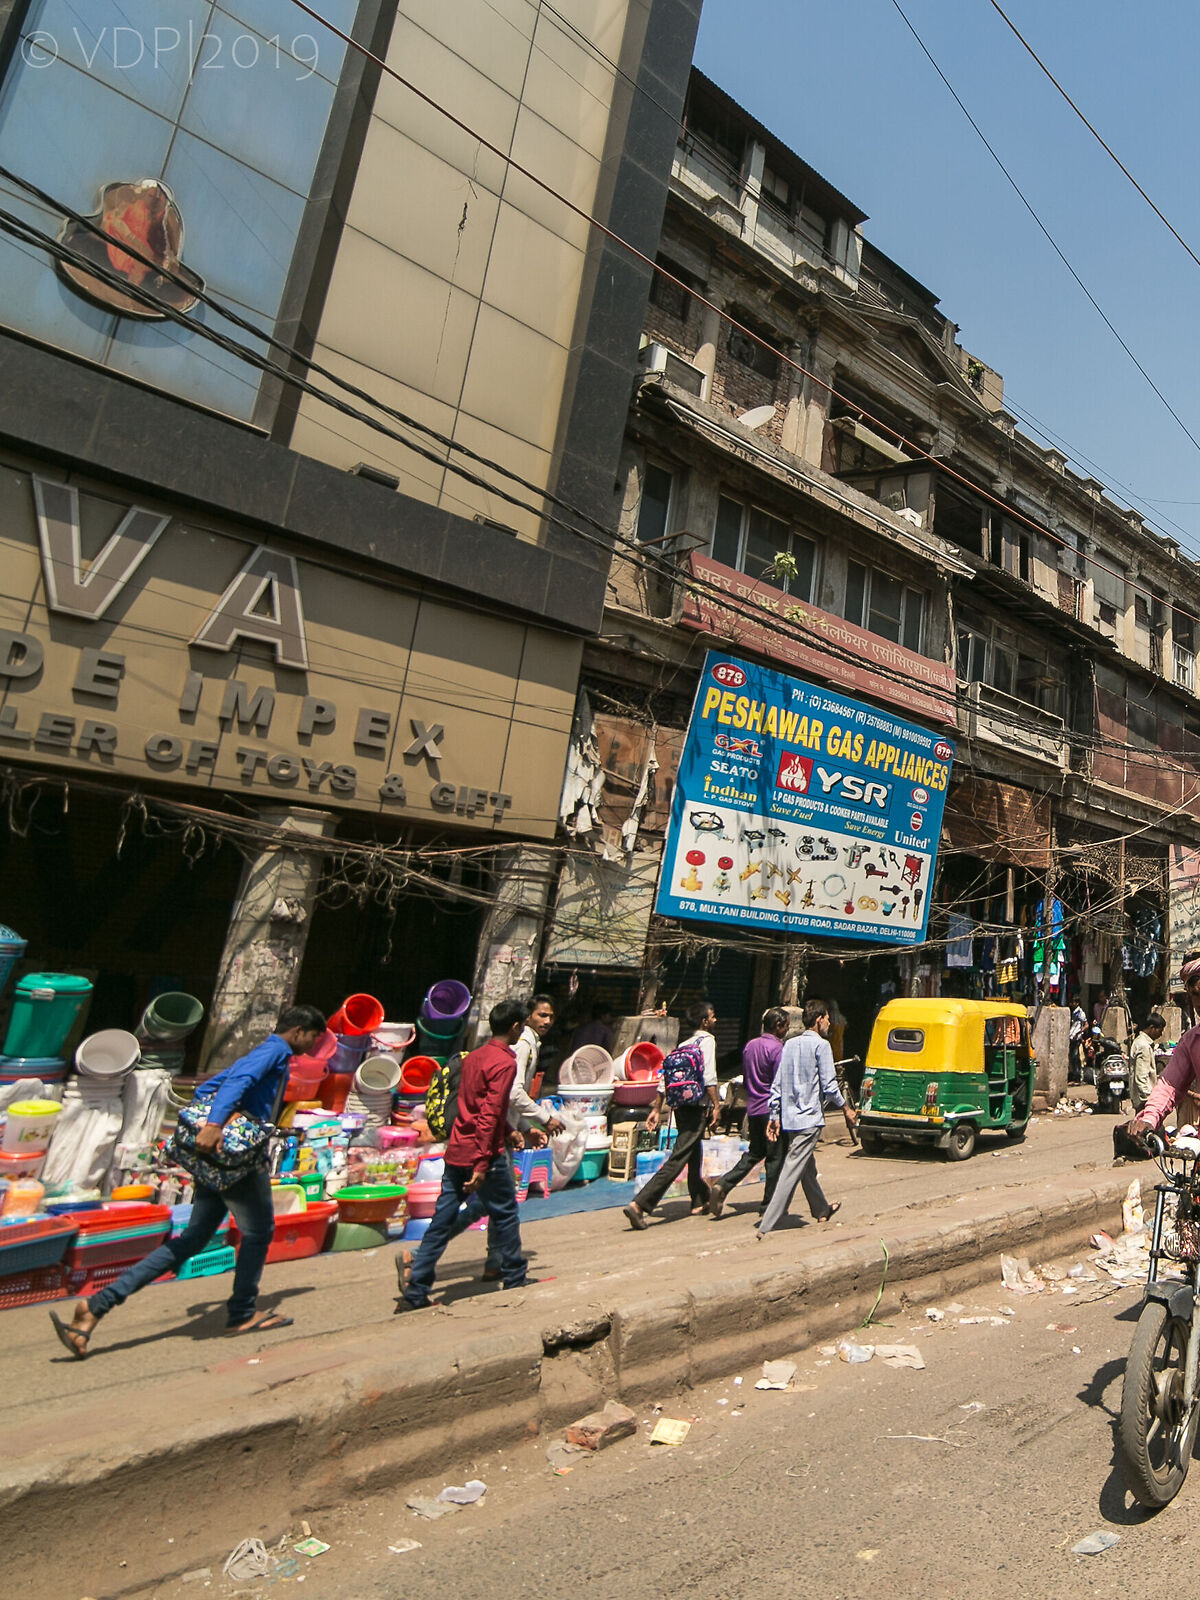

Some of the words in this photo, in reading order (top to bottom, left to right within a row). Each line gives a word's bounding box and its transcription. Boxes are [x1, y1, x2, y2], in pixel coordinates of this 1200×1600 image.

[695, 564, 733, 593] सदर
[716, 666, 744, 685] 878
[791, 687, 804, 702] PH
[178, 668, 445, 760] IMPEX
[701, 686, 824, 751] PESHAWAR
[826, 725, 865, 763] GAS
[863, 739, 949, 792] APPLIANCES
[712, 748, 725, 757] GAS
[726, 751, 761, 765] PRODUCTS
[936, 745, 951, 759] 878
[145, 733, 218, 769] OF
[236, 746, 357, 792] TOYS
[379, 772, 407, 801] &
[430, 781, 513, 818] GIFT
[710, 760, 758, 780] SEATO
[816, 766, 888, 808] YSR
[718, 796, 733, 804] GAS
[770, 803, 792, 815] Save
[792, 808, 814, 821] Fuel
[782, 793, 795, 806] GAS
[795, 795, 824, 813] PRODUCTS
[829, 805, 851, 819] COOKER
[851, 810, 865, 823] PARTS
[864, 813, 889, 828] AVAILABLE
[844, 820, 862, 832] Save
[862, 825, 886, 839] Energy
[894, 830, 928, 850] United
[679, 900, 697, 913] 878,
[699, 903, 739, 917] MULTANI
[739, 908, 781, 923] BUILDING,
[810, 918, 833, 930] ROAD,
[833, 921, 856, 932] SADAR
[856, 924, 879, 935] BAZAR,
